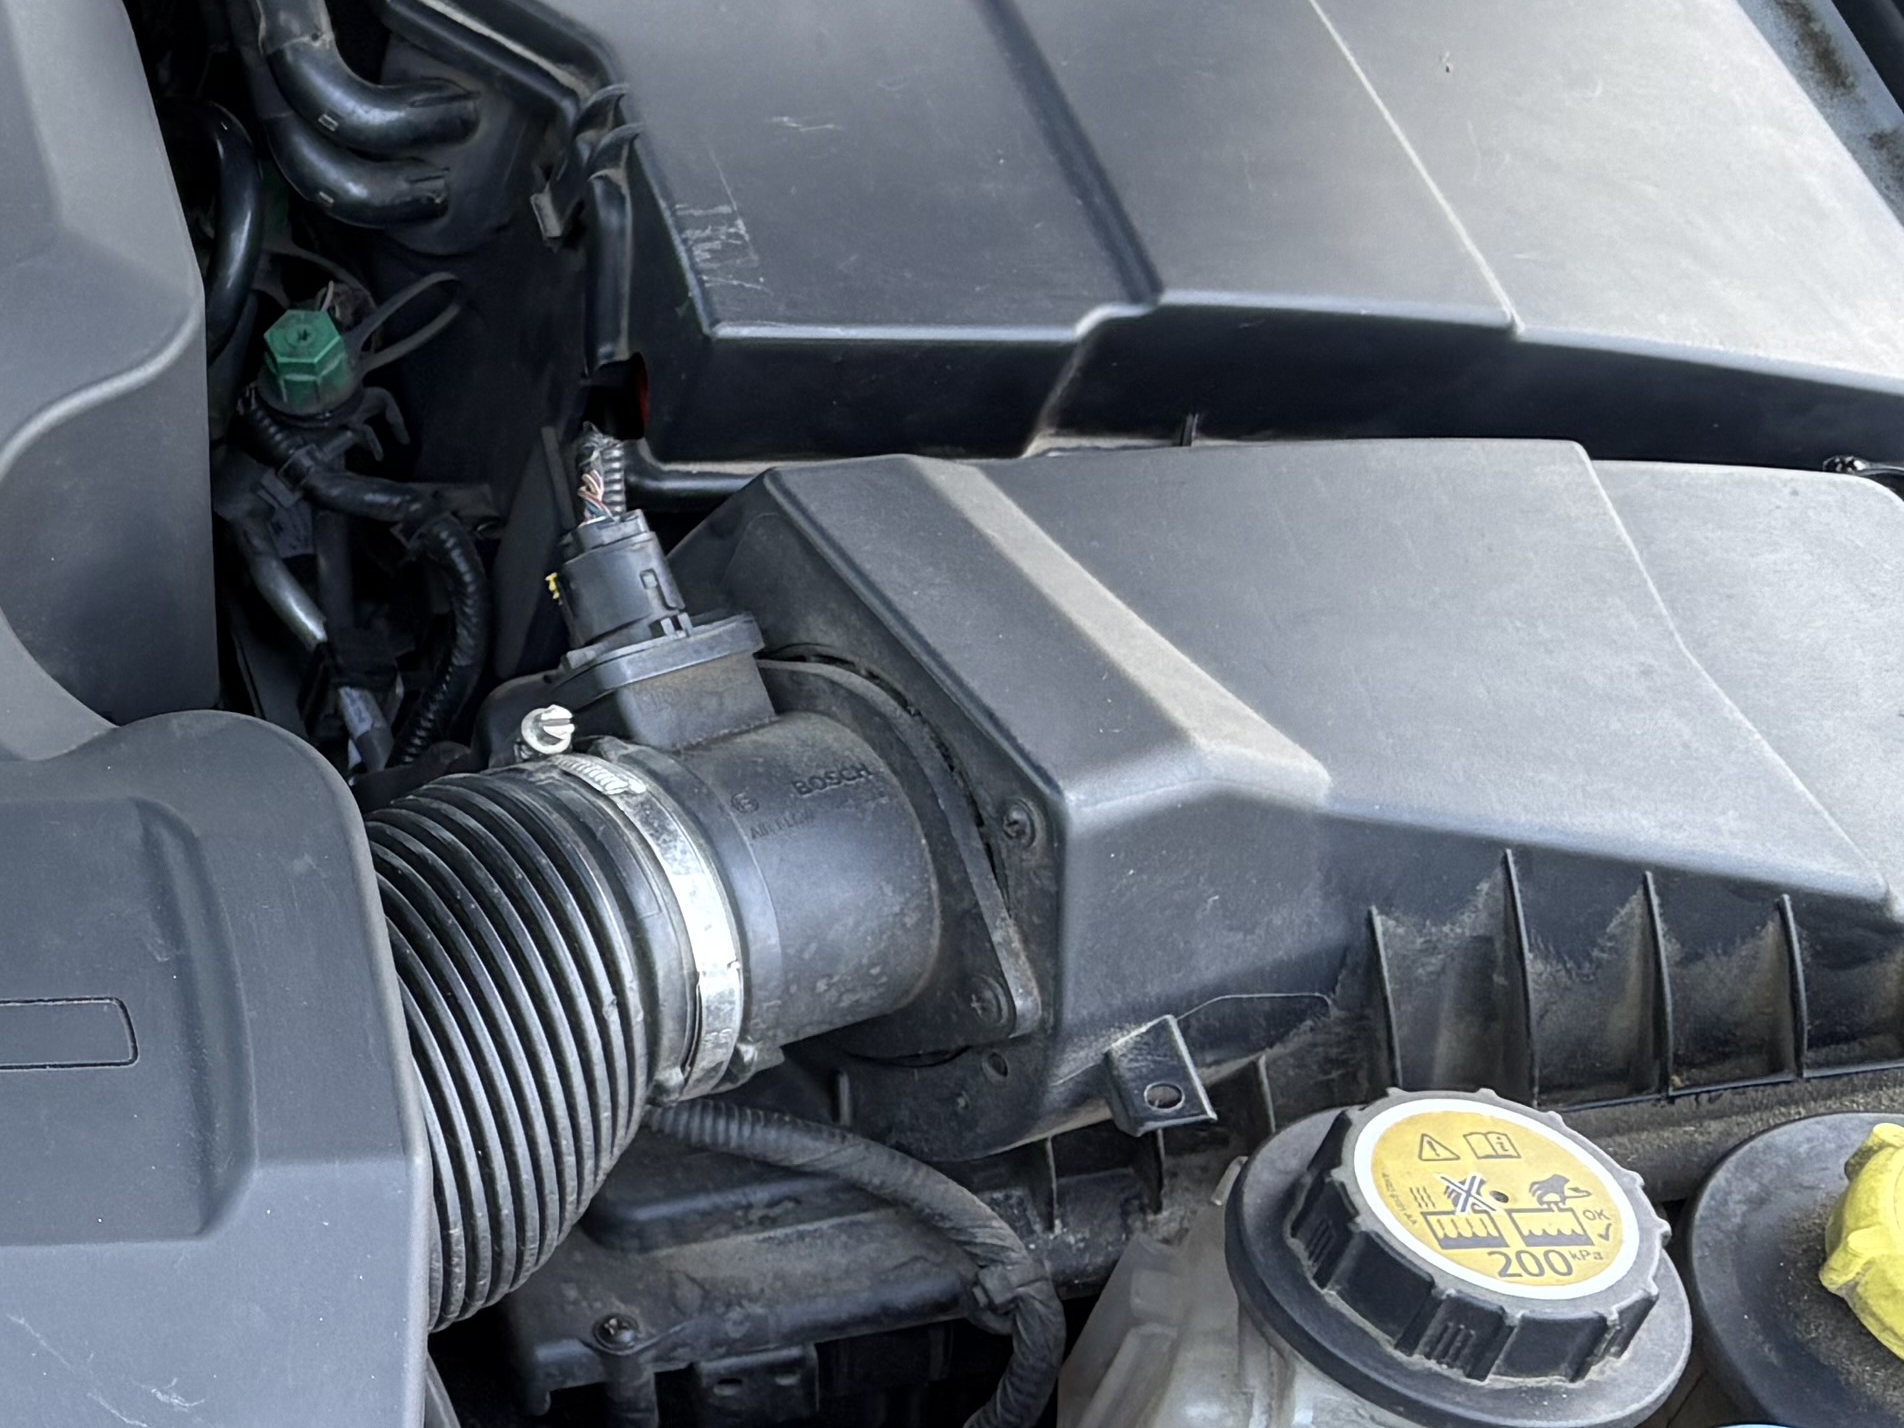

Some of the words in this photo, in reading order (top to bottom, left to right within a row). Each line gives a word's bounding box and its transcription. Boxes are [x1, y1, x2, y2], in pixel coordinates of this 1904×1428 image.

[793, 762, 873, 797] BOSCH
[1582, 1208, 1613, 1222] OK
[1487, 1249, 1573, 1278] 200
[1570, 1249, 1604, 1263] kPa
